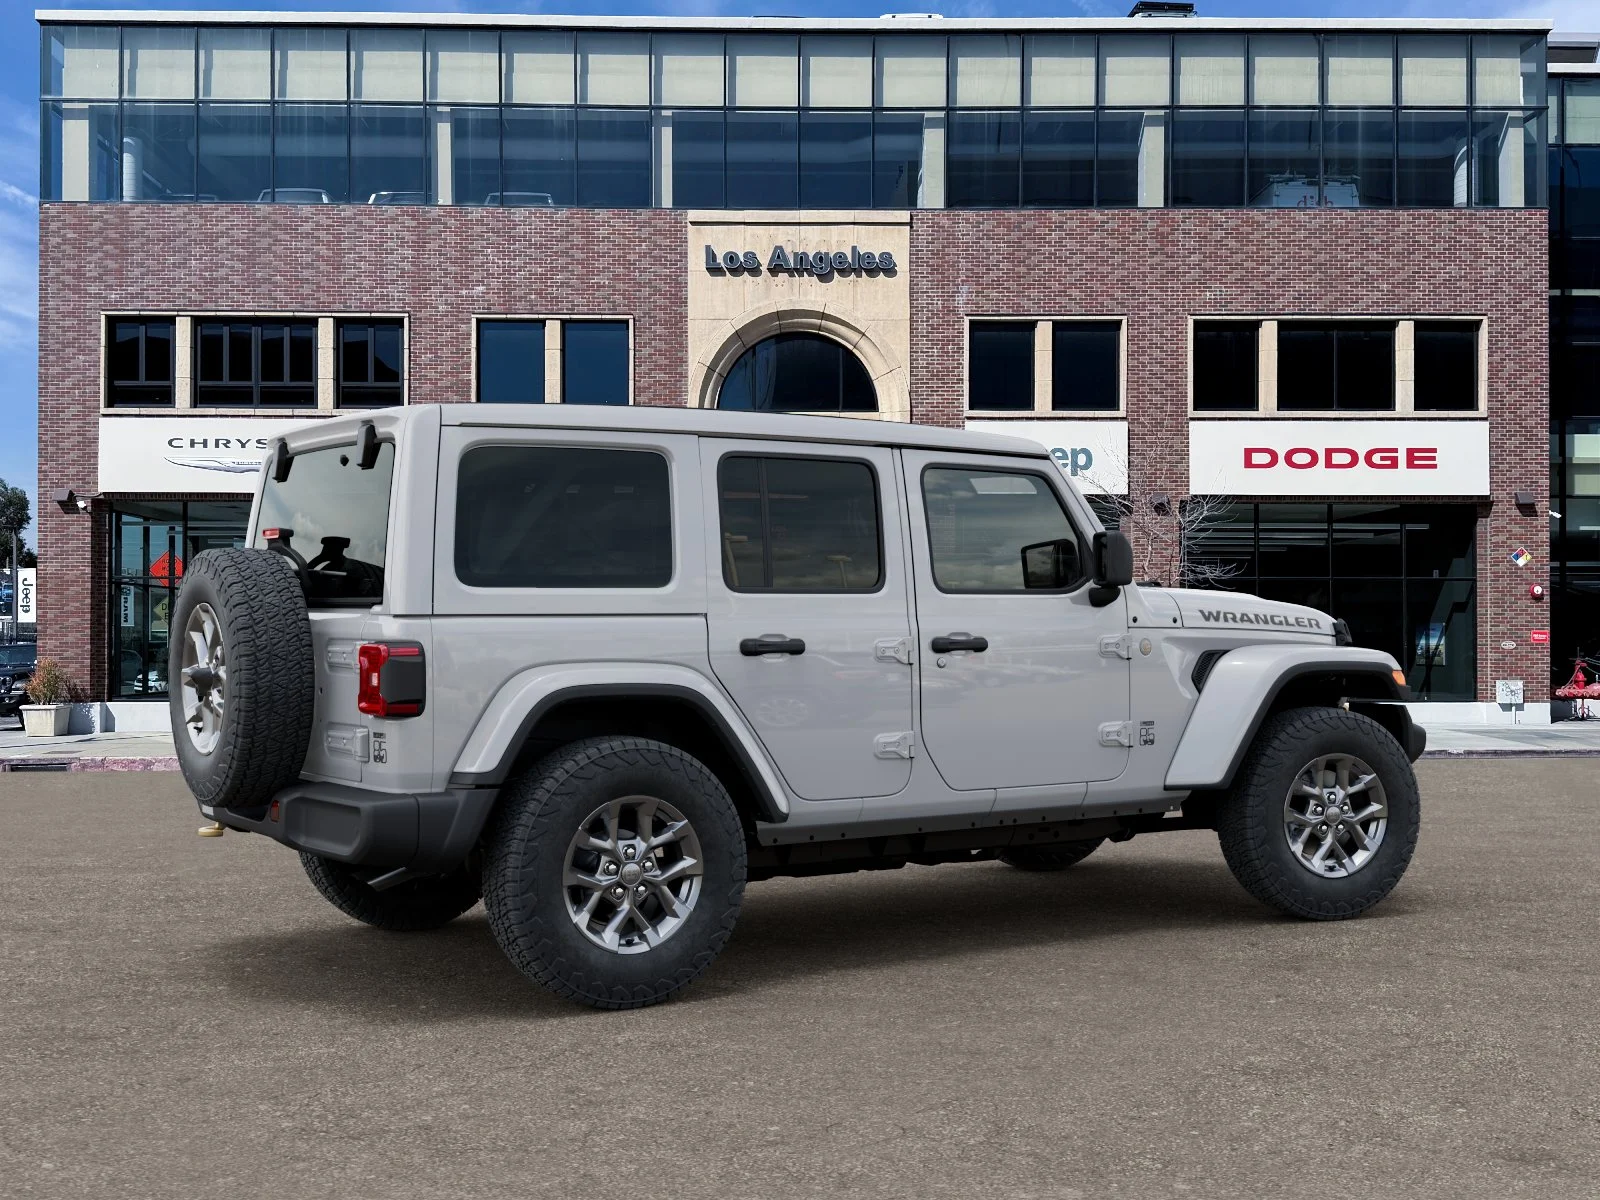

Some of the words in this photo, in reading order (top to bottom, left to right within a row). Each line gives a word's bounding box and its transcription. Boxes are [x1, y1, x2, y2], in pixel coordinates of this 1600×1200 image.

[705, 245, 757, 268] Los
[767, 245, 893, 274] Angeles
[1244, 447, 1438, 470] DODGE
[20, 577, 33, 613] Jeep
[1198, 609, 1322, 629] WRANGLER
